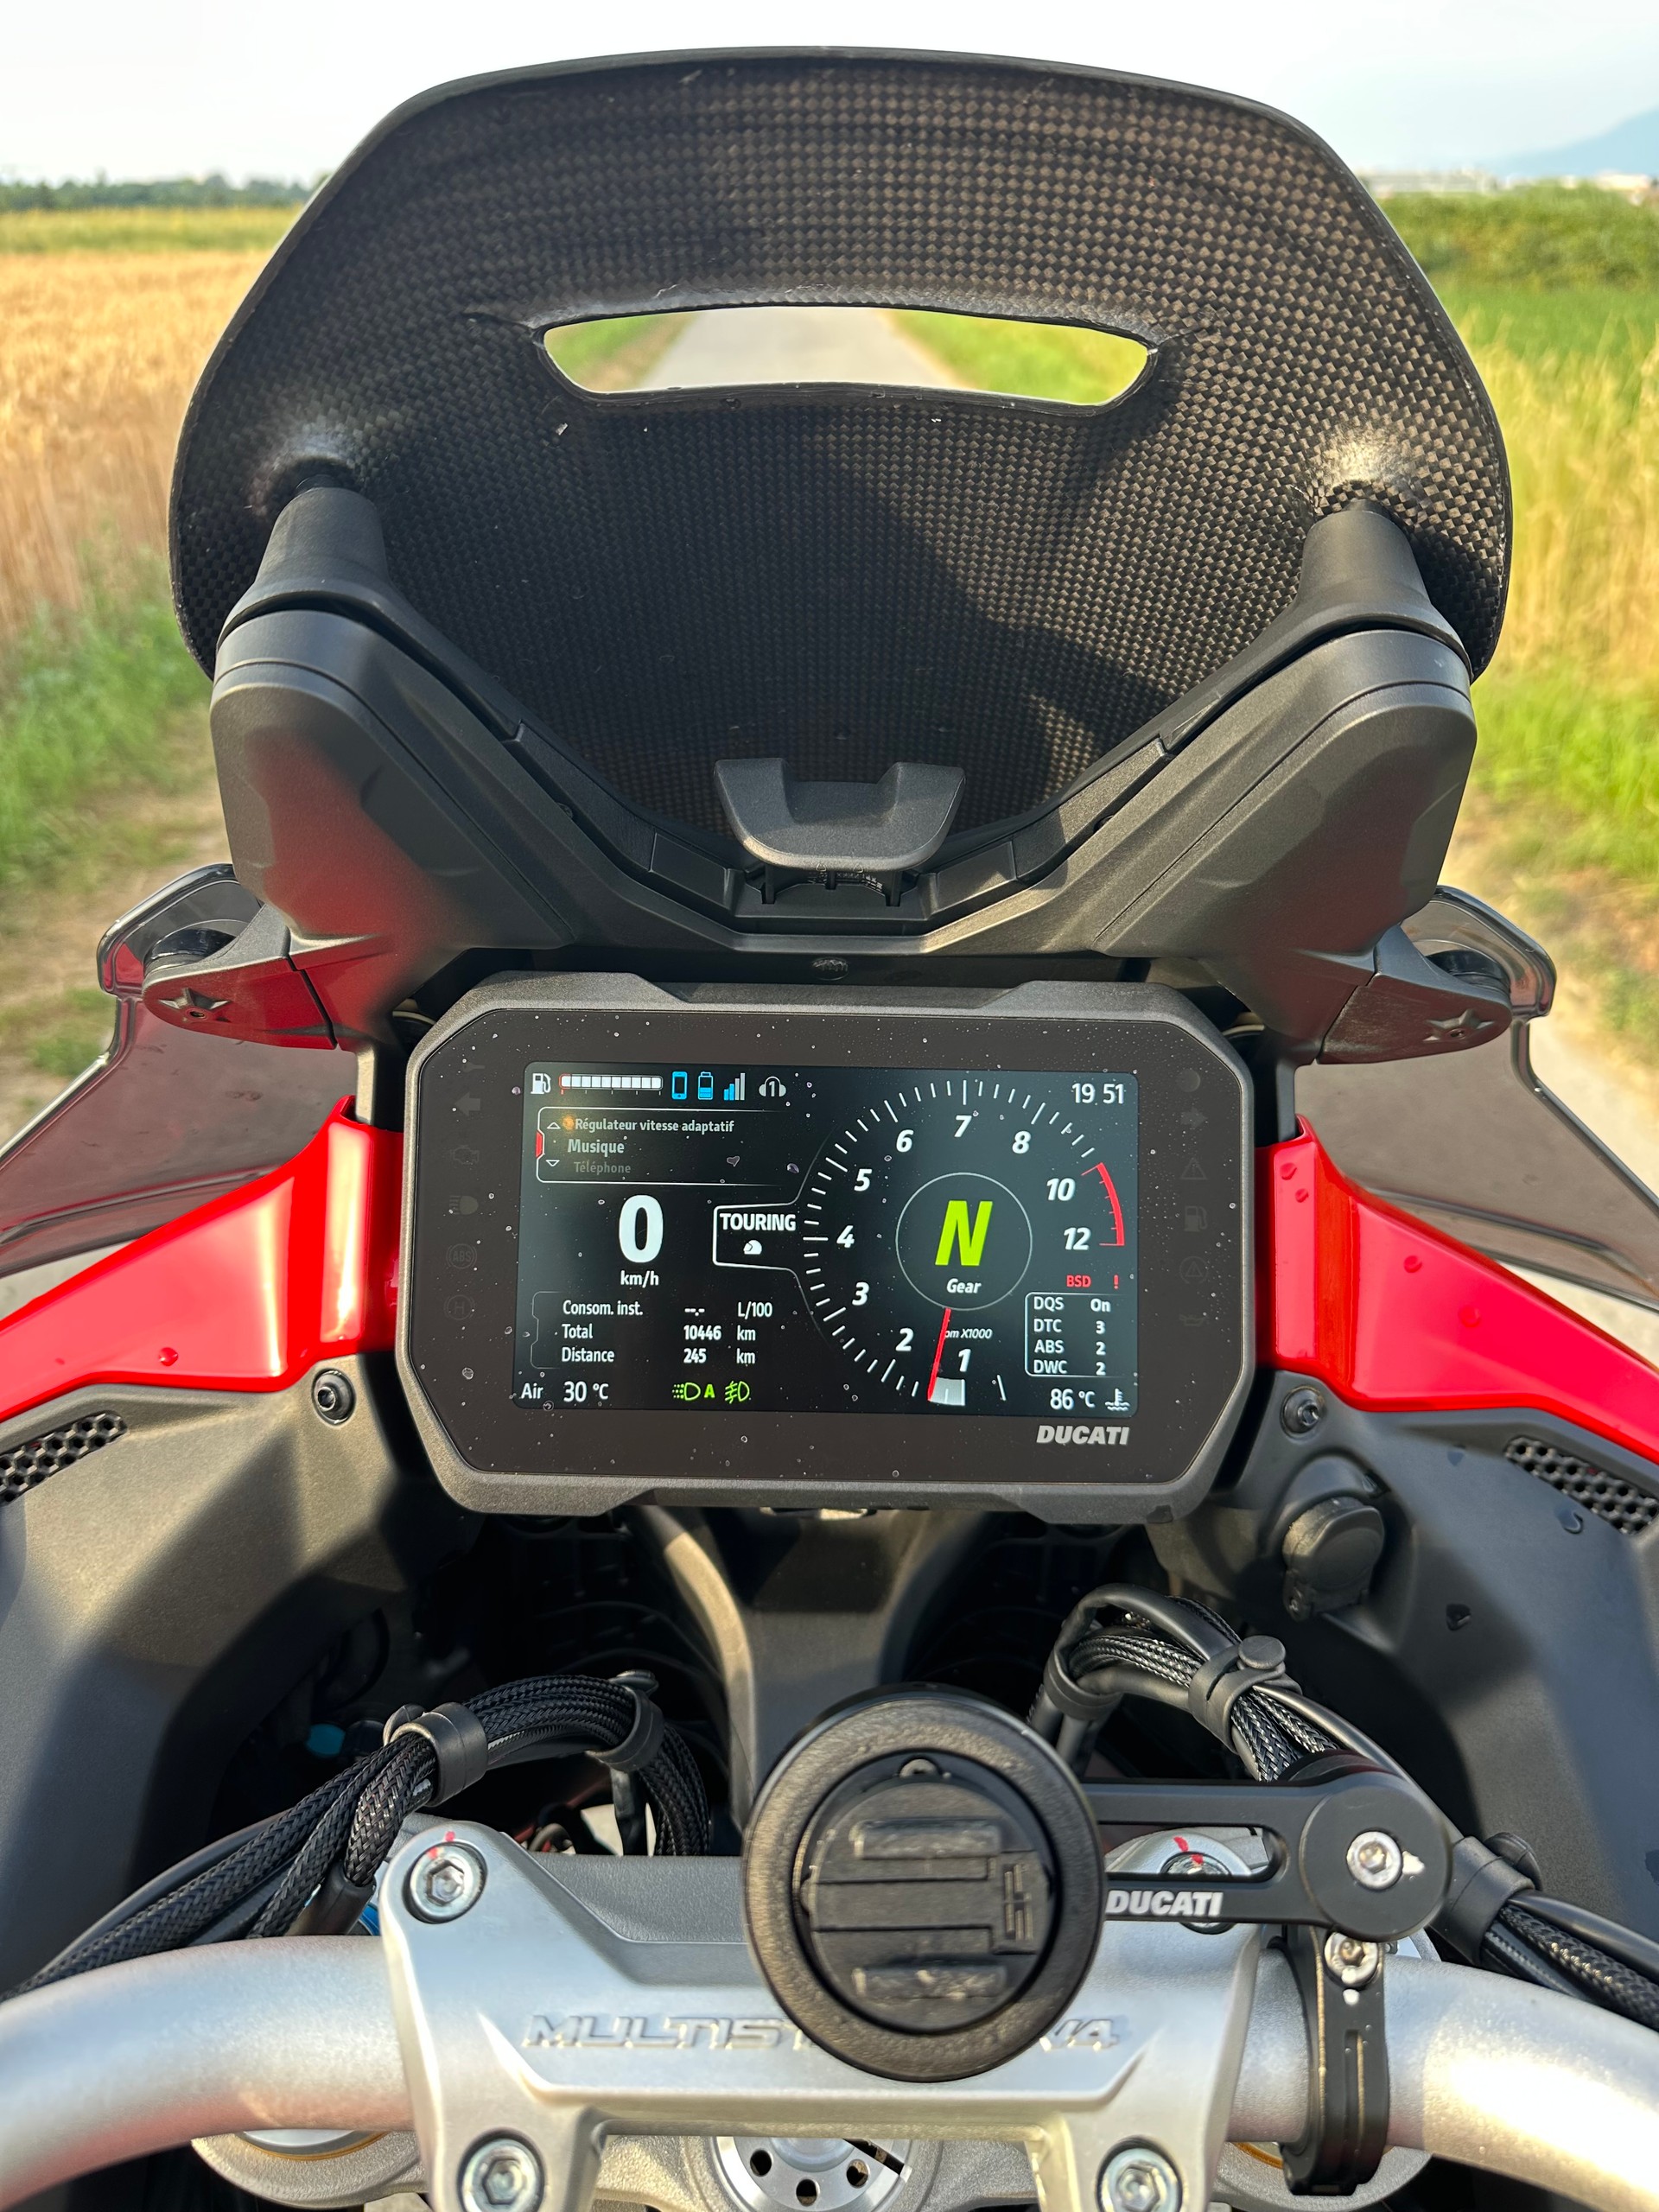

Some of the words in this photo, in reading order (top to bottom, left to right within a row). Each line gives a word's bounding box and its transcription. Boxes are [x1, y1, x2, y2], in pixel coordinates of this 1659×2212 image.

[1071, 1084, 1095, 1103] 19
[1103, 1084, 1123, 1103] 51
[575, 1117, 637, 1133] Régulateur
[639, 1120, 678, 1130] vitesse
[682, 1120, 734, 1135] adaptatif
[955, 1116, 971, 1137] 7
[568, 1139, 624, 1155] Musique
[897, 1130, 913, 1152] 6
[1013, 1131, 1031, 1154] 8
[574, 1161, 631, 1174] Téléphone
[855, 1169, 872, 1191] 5
[1047, 1179, 1075, 1201] 10
[619, 1195, 663, 1262] 0
[720, 1213, 796, 1230] TOURING
[836, 1225, 855, 1248] 4
[935, 1201, 993, 1266] N
[1064, 1228, 1090, 1249] 12
[620, 1270, 658, 1287] km/h
[947, 1279, 982, 1294] Gear
[1067, 1275, 1090, 1287] BSD
[852, 1282, 869, 1306] 3
[563, 1300, 613, 1315] Consom.
[618, 1300, 643, 1315] inst.
[738, 1301, 772, 1319] L/100
[1034, 1296, 1064, 1312] DQS
[1090, 1299, 1110, 1312] On
[562, 1324, 593, 1338] Total
[684, 1325, 721, 1340] 10446
[737, 1325, 755, 1340] km
[961, 1329, 992, 1338] X1000
[1034, 1319, 1061, 1332] DTC
[1096, 1321, 1105, 1334] 3
[896, 1328, 913, 1351] 2
[1034, 1339, 1064, 1353] ABS
[1096, 1342, 1106, 1355] 2
[562, 1347, 614, 1362] Distance
[683, 1348, 706, 1363] 245
[737, 1348, 755, 1363] km
[959, 1349, 970, 1372] 1
[1034, 1360, 1067, 1374] DWC
[1096, 1362, 1105, 1376] 2
[521, 1383, 543, 1399] Air
[564, 1382, 587, 1402] 30
[593, 1383, 608, 1399] °C
[704, 1384, 715, 1398] A
[1051, 1389, 1074, 1410] 86
[1078, 1391, 1095, 1408] °C
[1037, 1426, 1129, 1445] DUCATI
[1105, 1891, 1223, 1916] DUCATI
[522, 2015, 805, 2050] MULTIST
